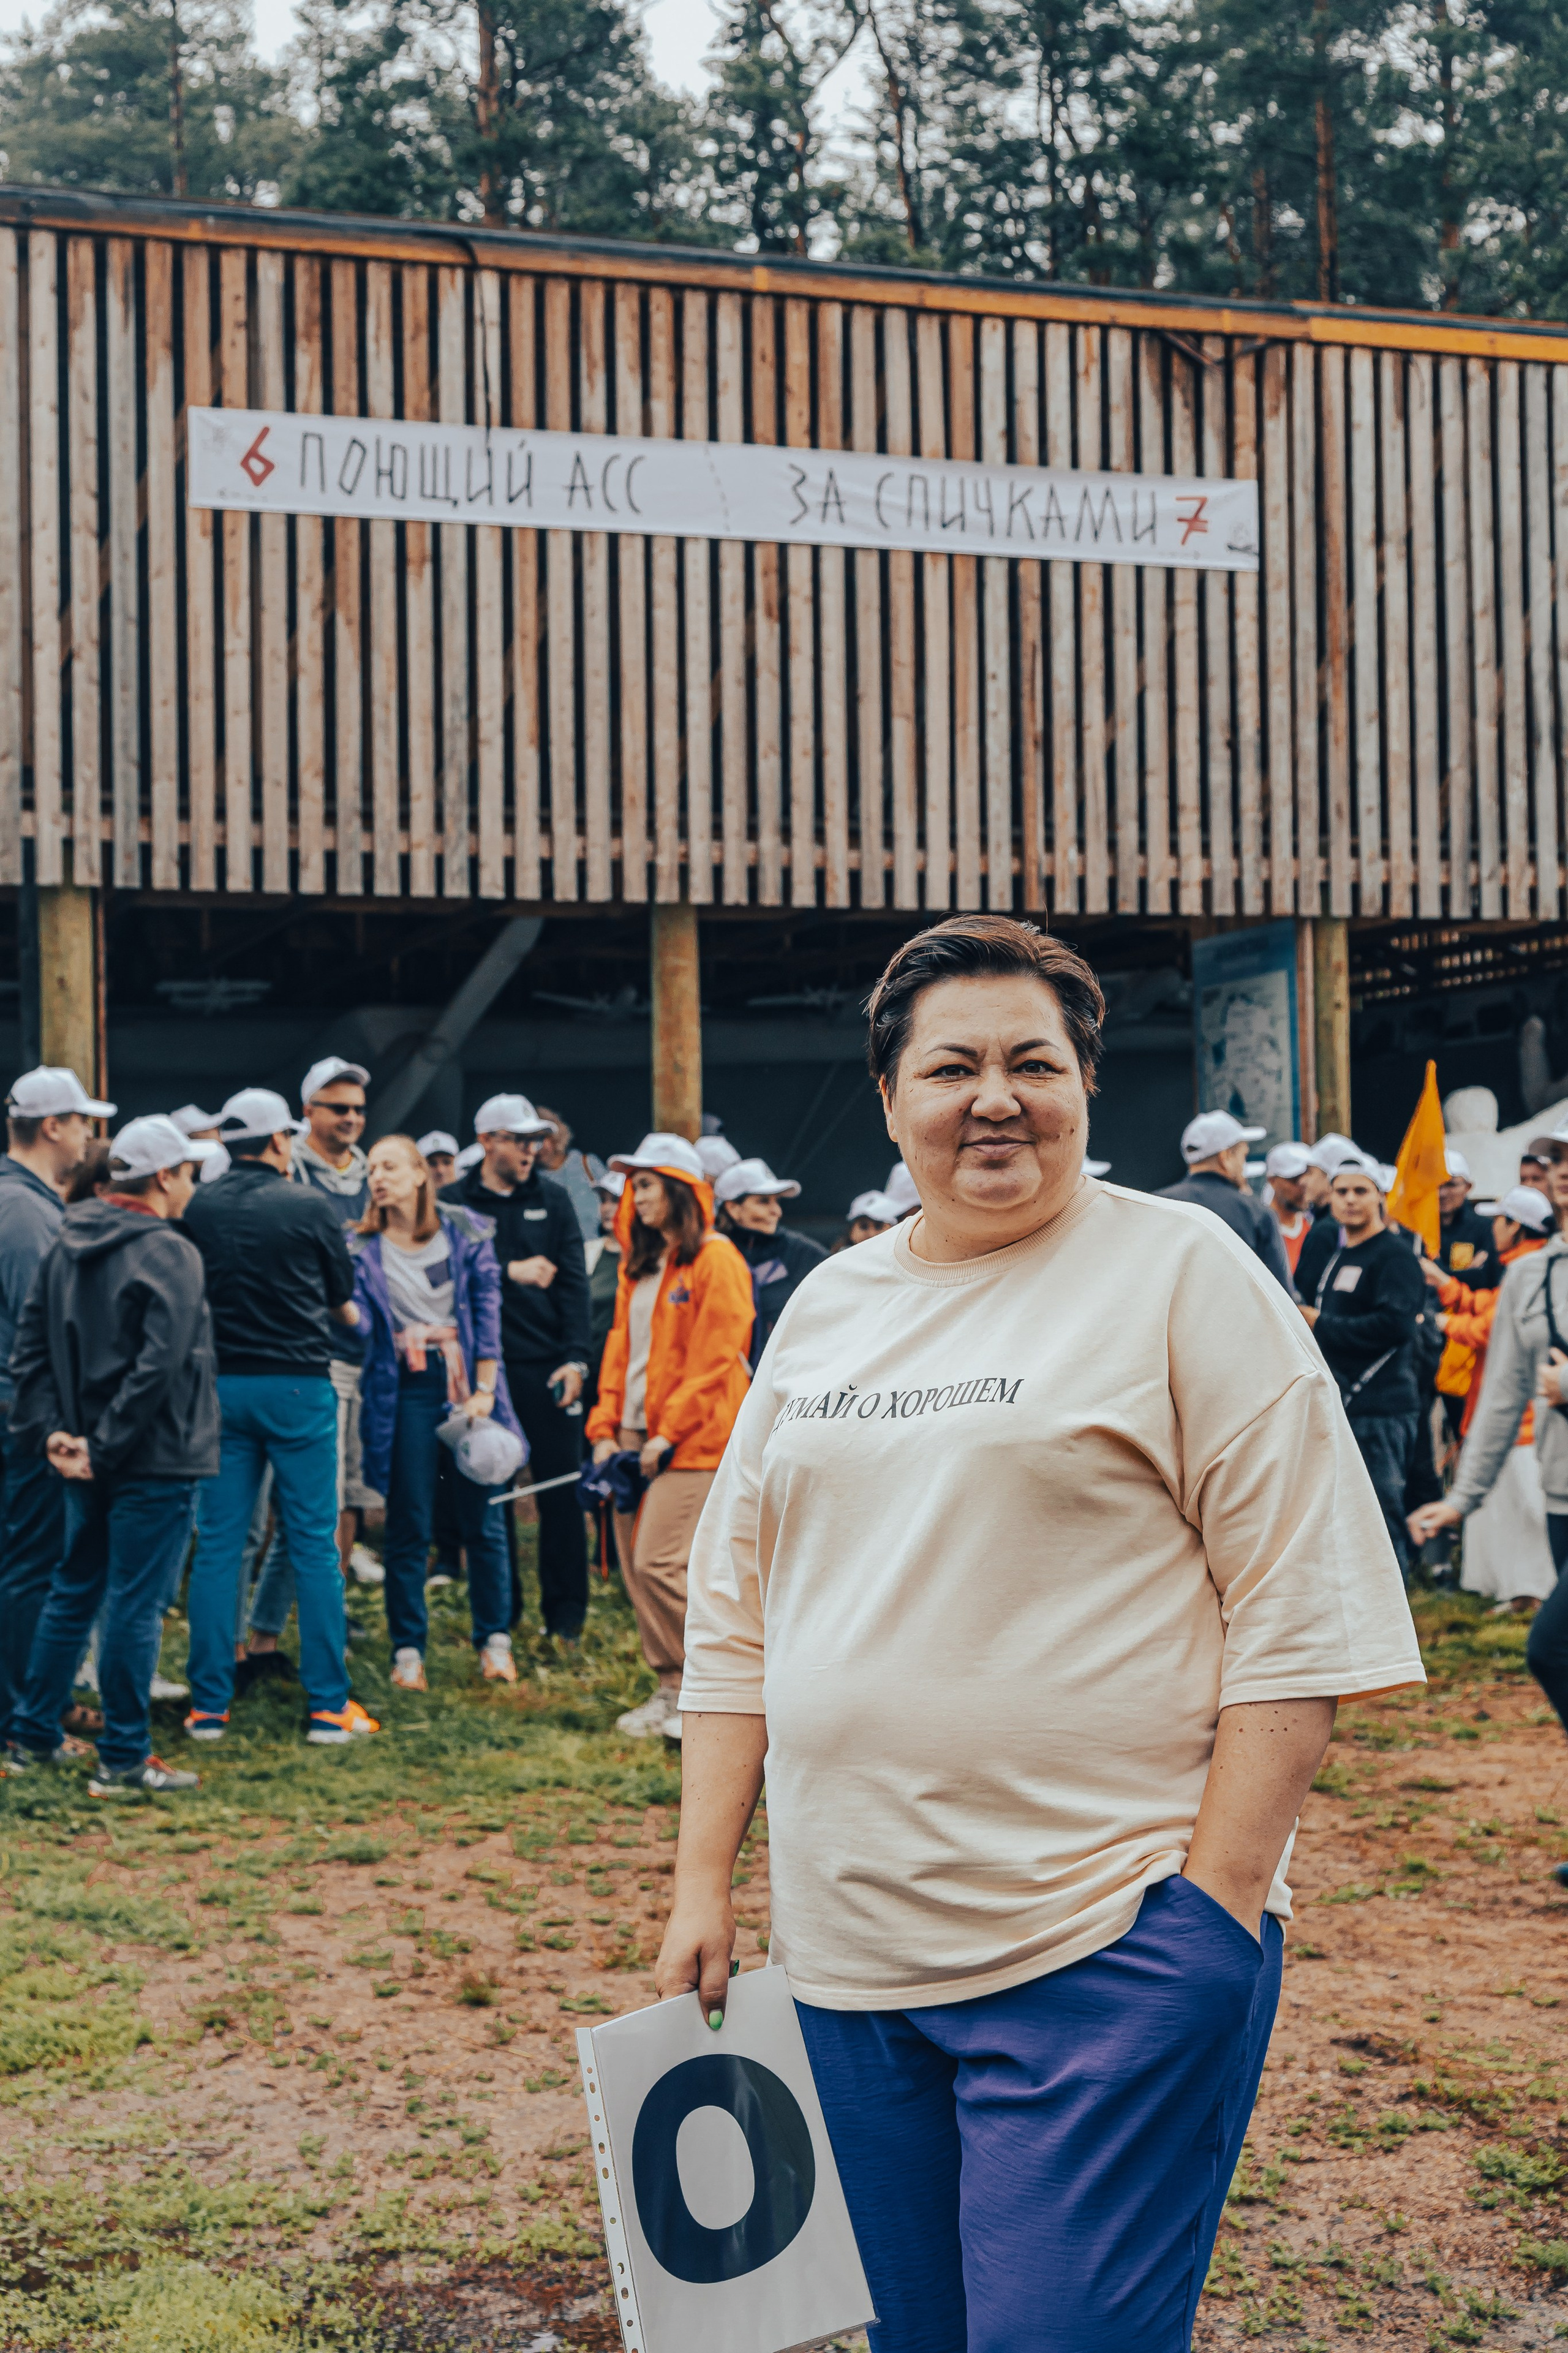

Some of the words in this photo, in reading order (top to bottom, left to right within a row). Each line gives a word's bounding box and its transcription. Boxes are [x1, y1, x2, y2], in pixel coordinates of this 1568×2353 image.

[240, 426, 276, 487] 6
[300, 431, 534, 509] ПОЮЩИЙ
[564, 451, 647, 515] АСС
[788, 463, 846, 523] ЗА
[875, 472, 1156, 545] СПИЧКАМИ
[1176, 496, 1208, 546] 7
[858, 1392, 881, 1420] О
[881, 1377, 1025, 1420] ХОРОШЕМ
